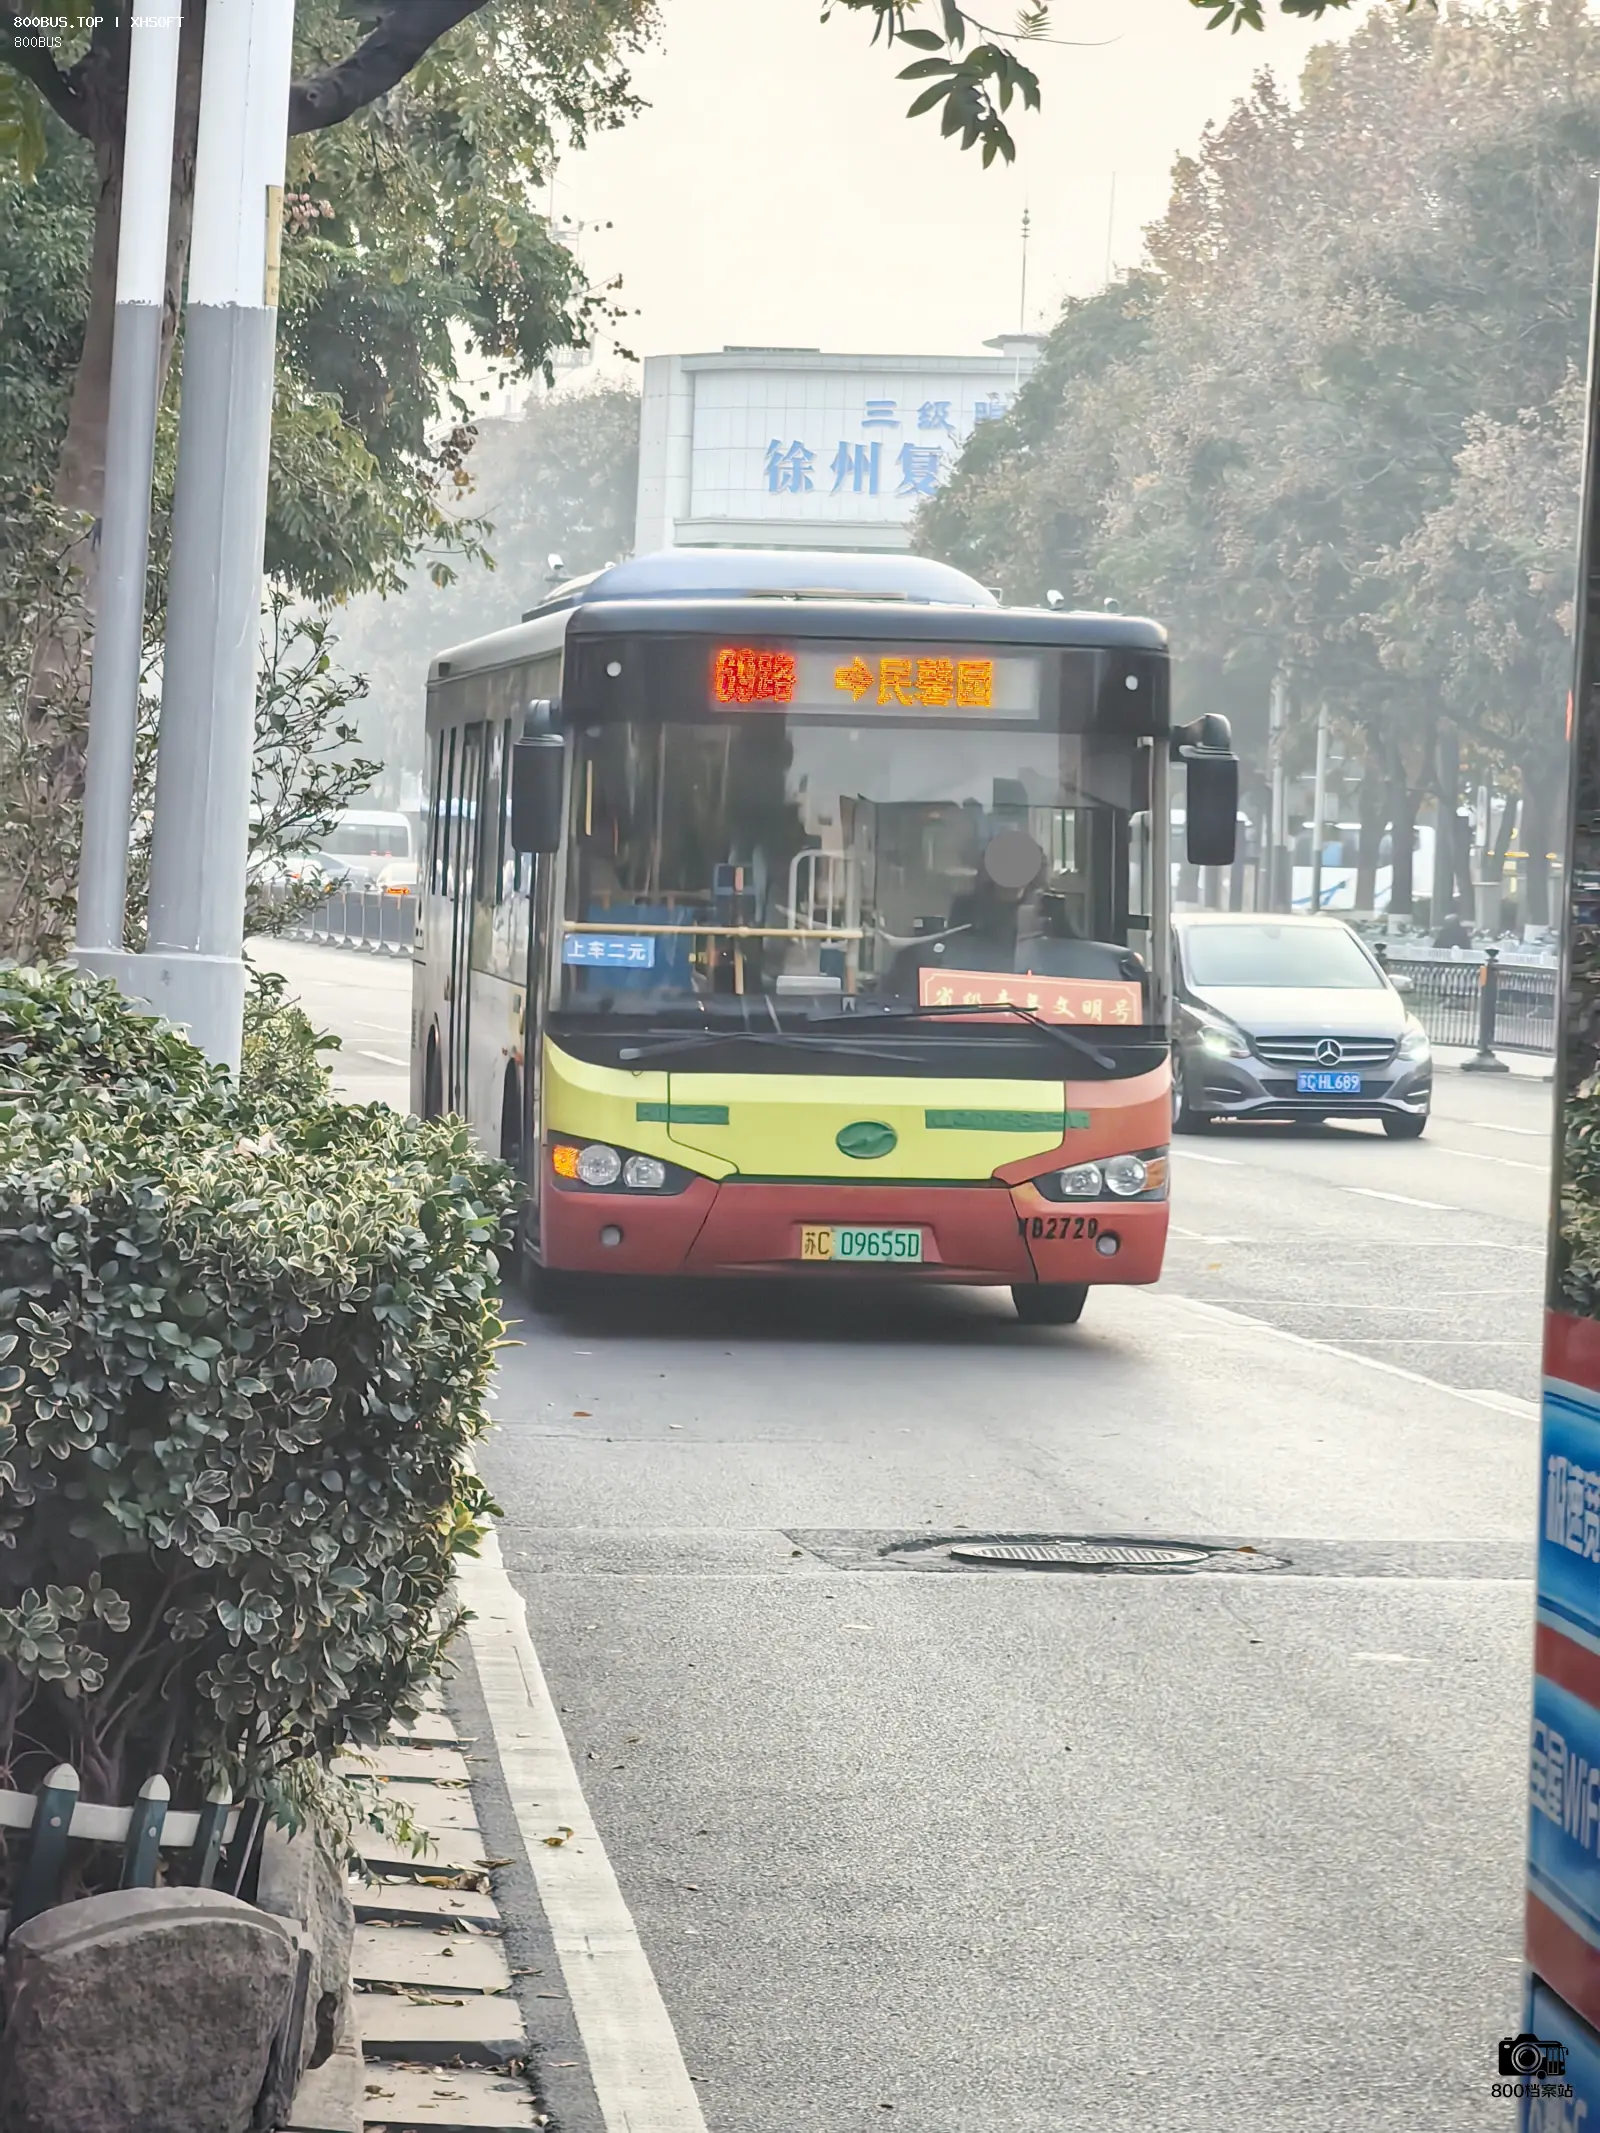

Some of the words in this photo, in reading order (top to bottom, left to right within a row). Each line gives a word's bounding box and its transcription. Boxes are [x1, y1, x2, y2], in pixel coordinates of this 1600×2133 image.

[765, 438, 942, 498] 徐州复
[567, 940, 646, 961] 上车二元
